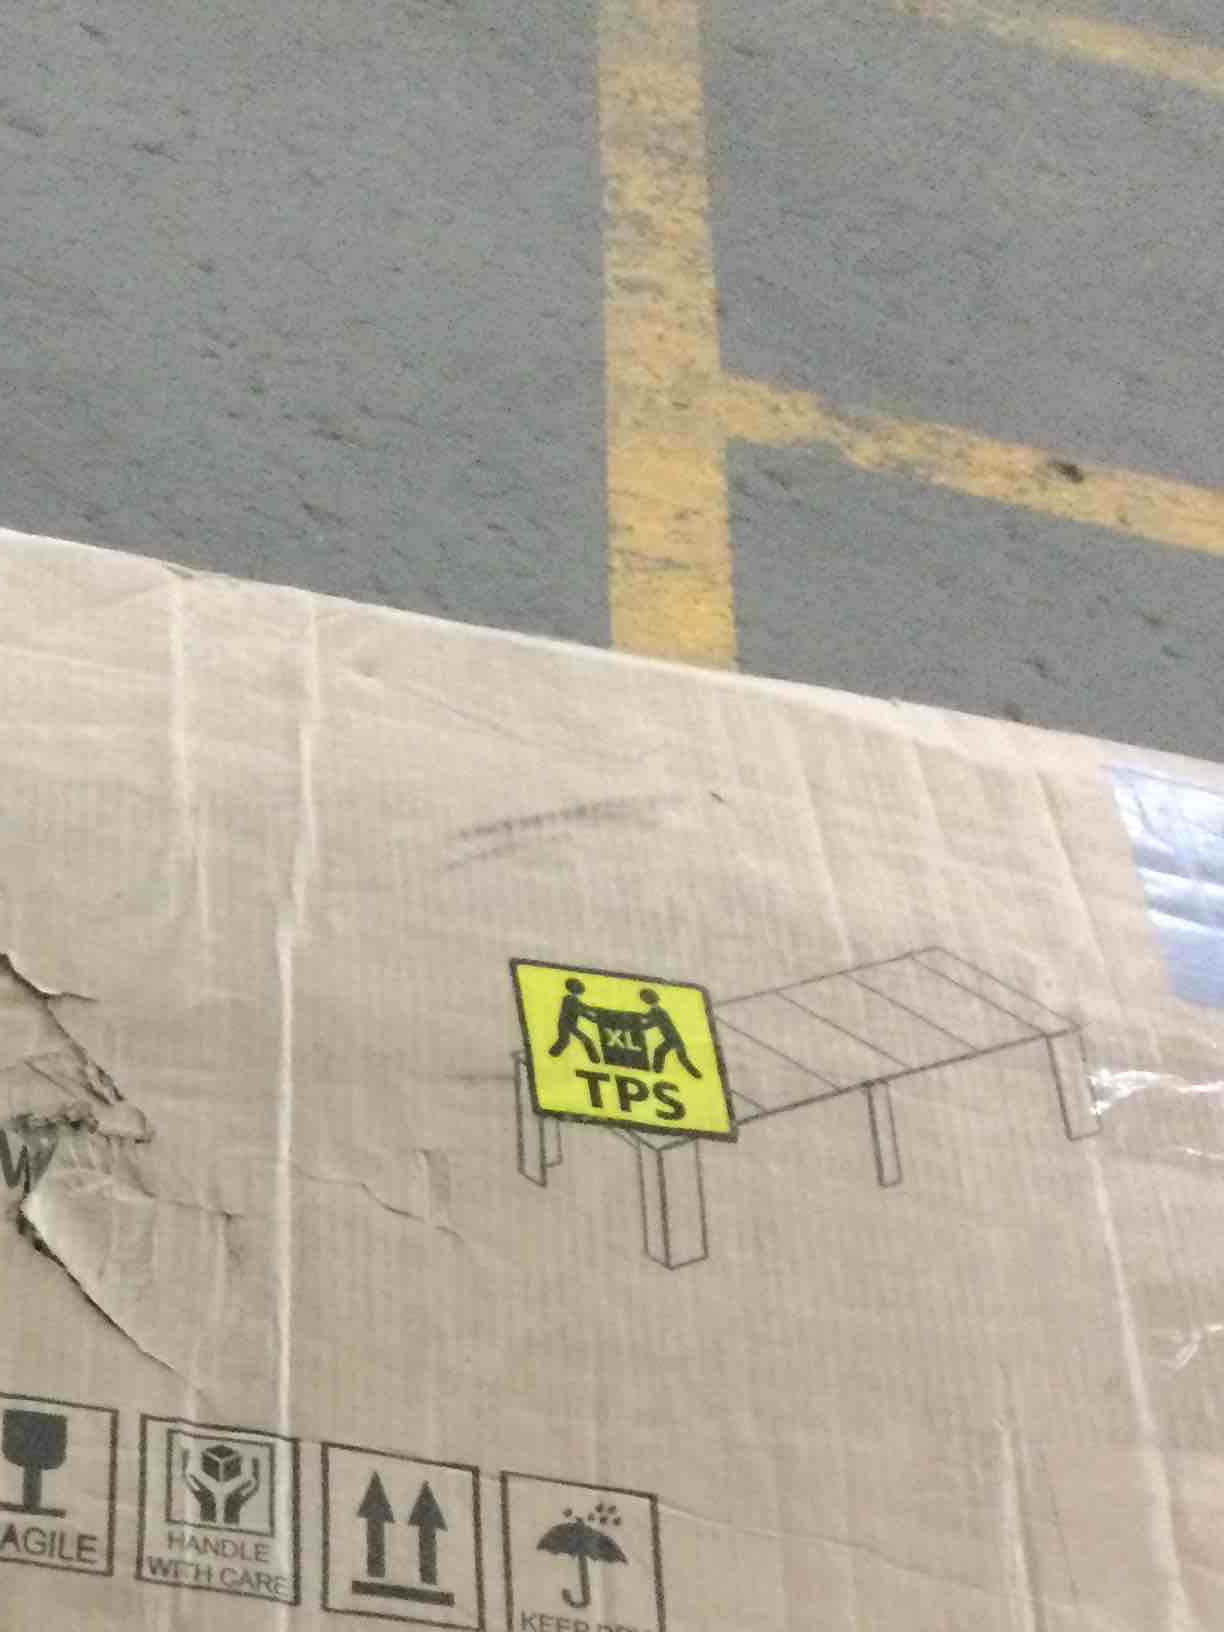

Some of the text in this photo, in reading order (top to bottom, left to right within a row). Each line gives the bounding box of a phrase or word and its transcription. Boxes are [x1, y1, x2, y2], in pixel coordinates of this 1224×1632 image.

[604, 1028, 644, 1050] XL
[575, 1069, 687, 1121] TPS
[167, 1531, 270, 1564] HANDLE
